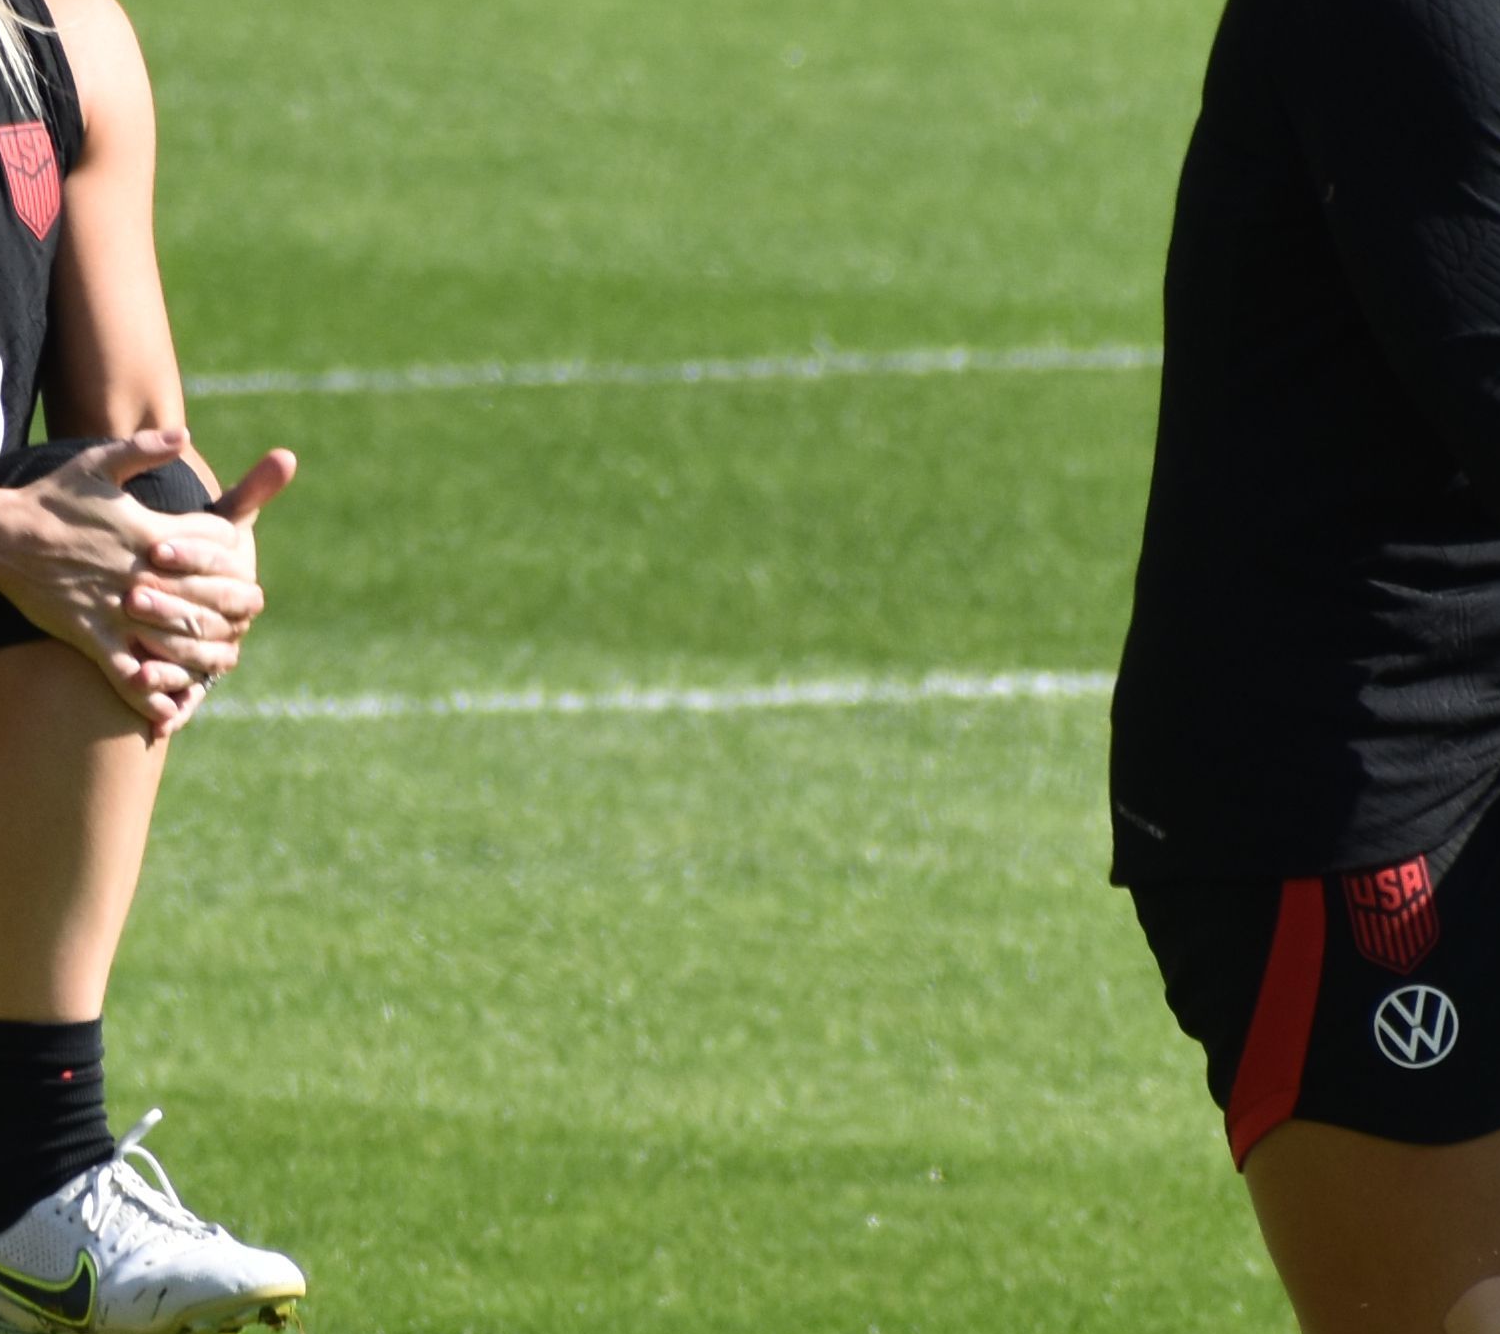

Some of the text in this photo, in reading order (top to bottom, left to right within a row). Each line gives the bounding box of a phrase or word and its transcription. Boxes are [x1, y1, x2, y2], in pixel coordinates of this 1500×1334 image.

[0, 131, 52, 176] USA
[1351, 863, 1423, 911] USA
[1375, 985, 1458, 1067] VW
